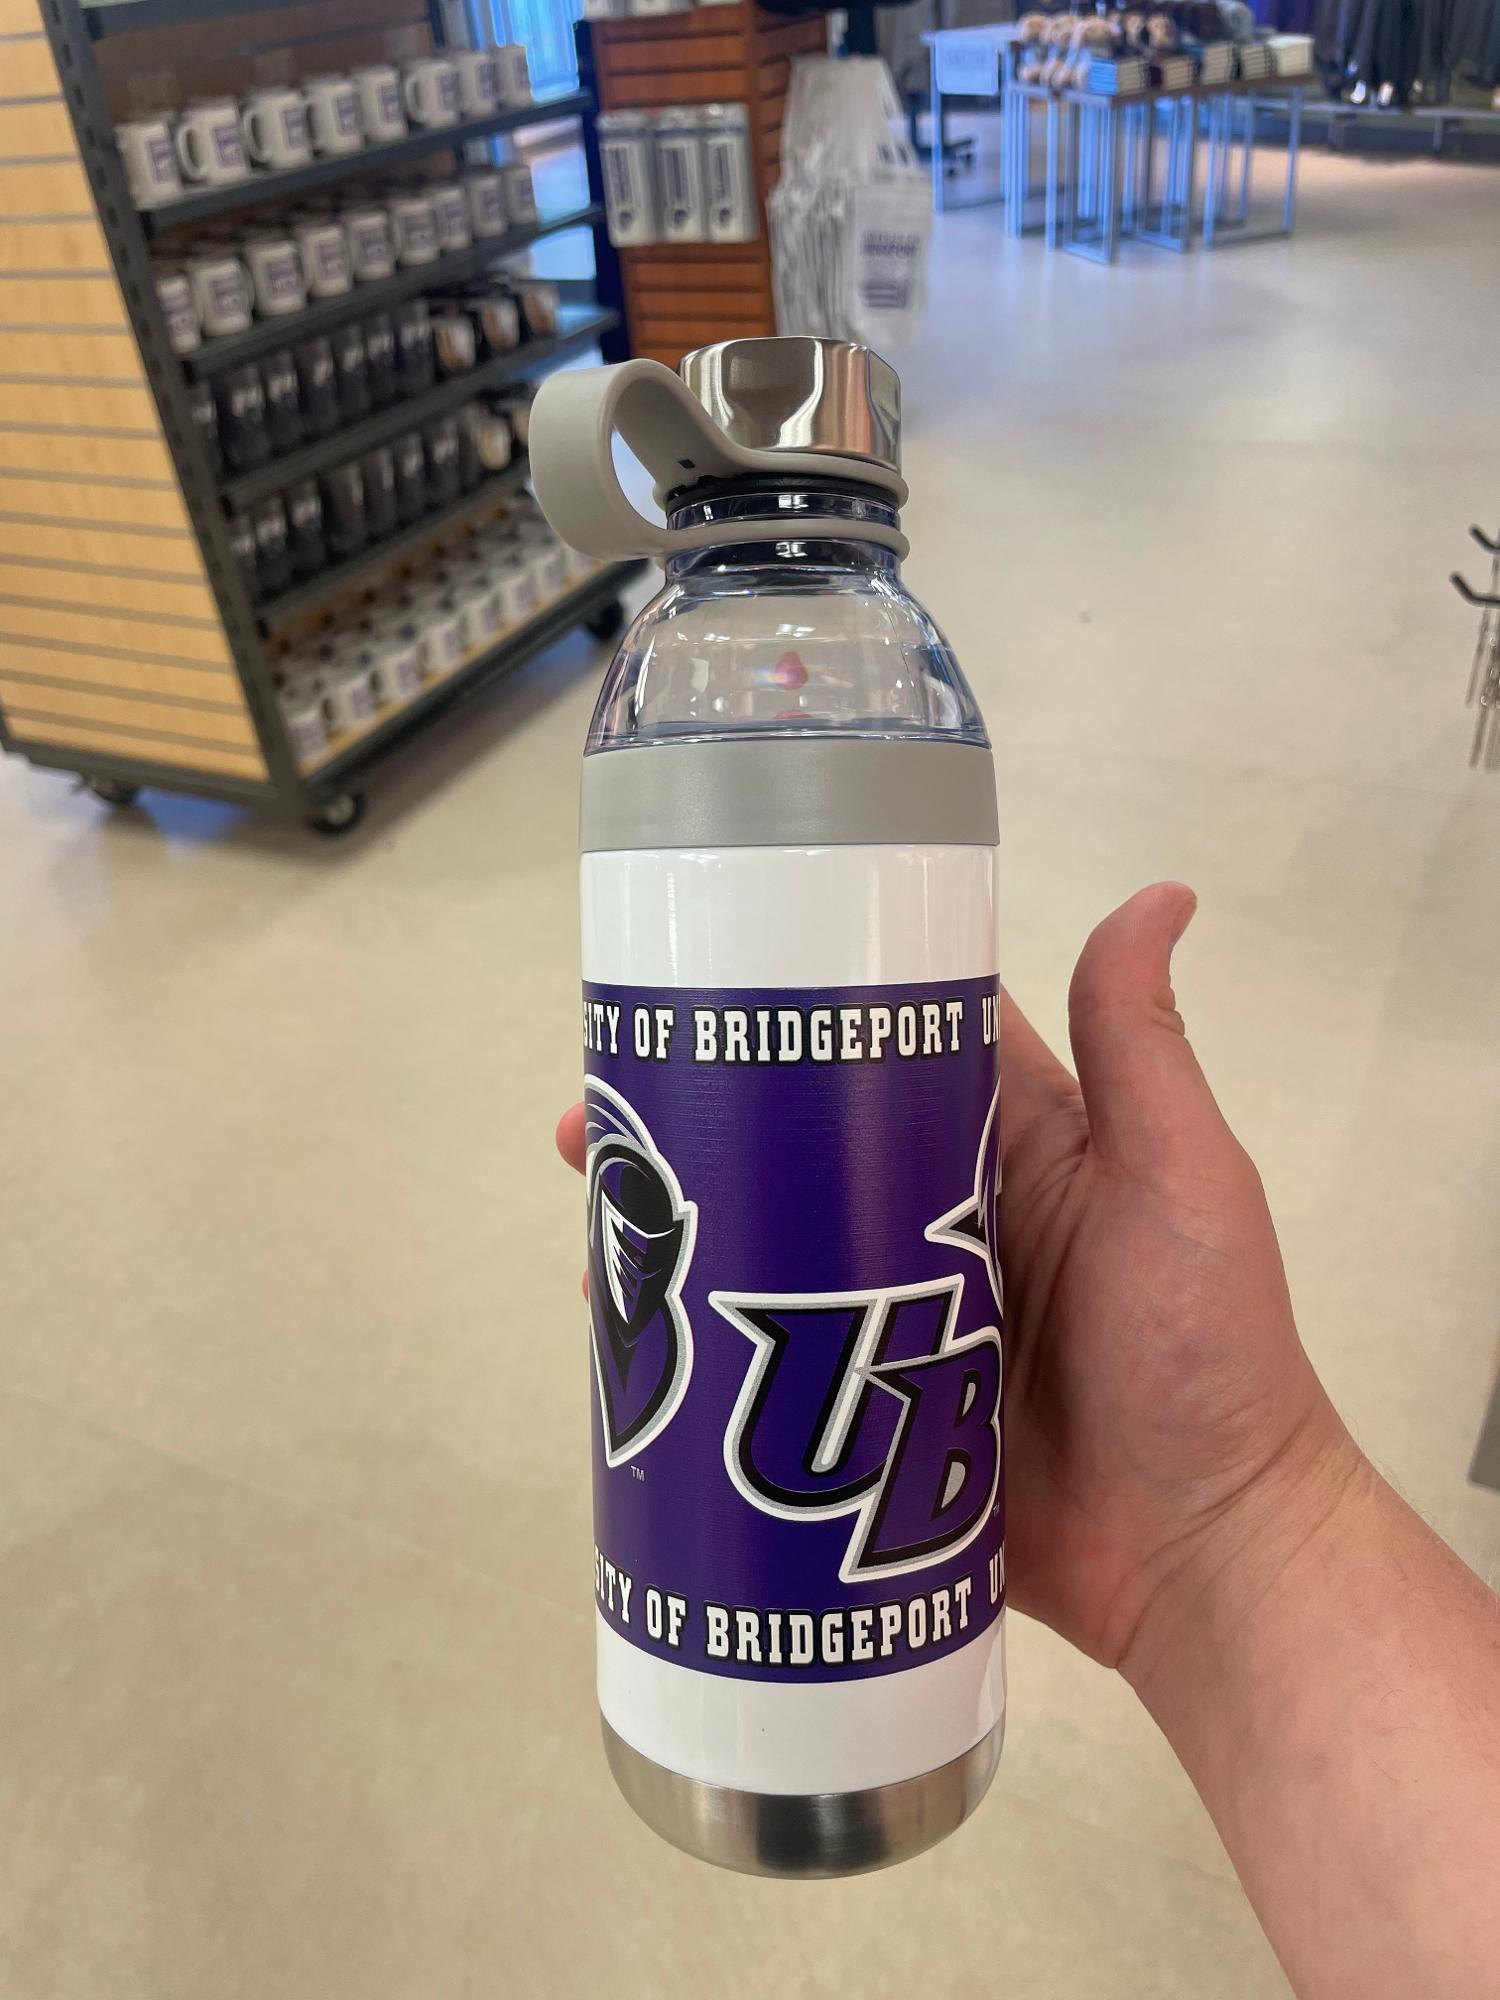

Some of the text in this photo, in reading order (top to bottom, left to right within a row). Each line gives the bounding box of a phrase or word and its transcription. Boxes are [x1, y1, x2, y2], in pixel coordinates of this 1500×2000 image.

[634, 1008, 674, 1059] OF
[693, 1001, 964, 1062] BRIDGEPORT
[707, 1272, 1003, 1584] UB
[630, 1465, 645, 1482] TM
[645, 1587, 686, 1646] OF
[706, 1576, 972, 1665] BRIDGEPORT
